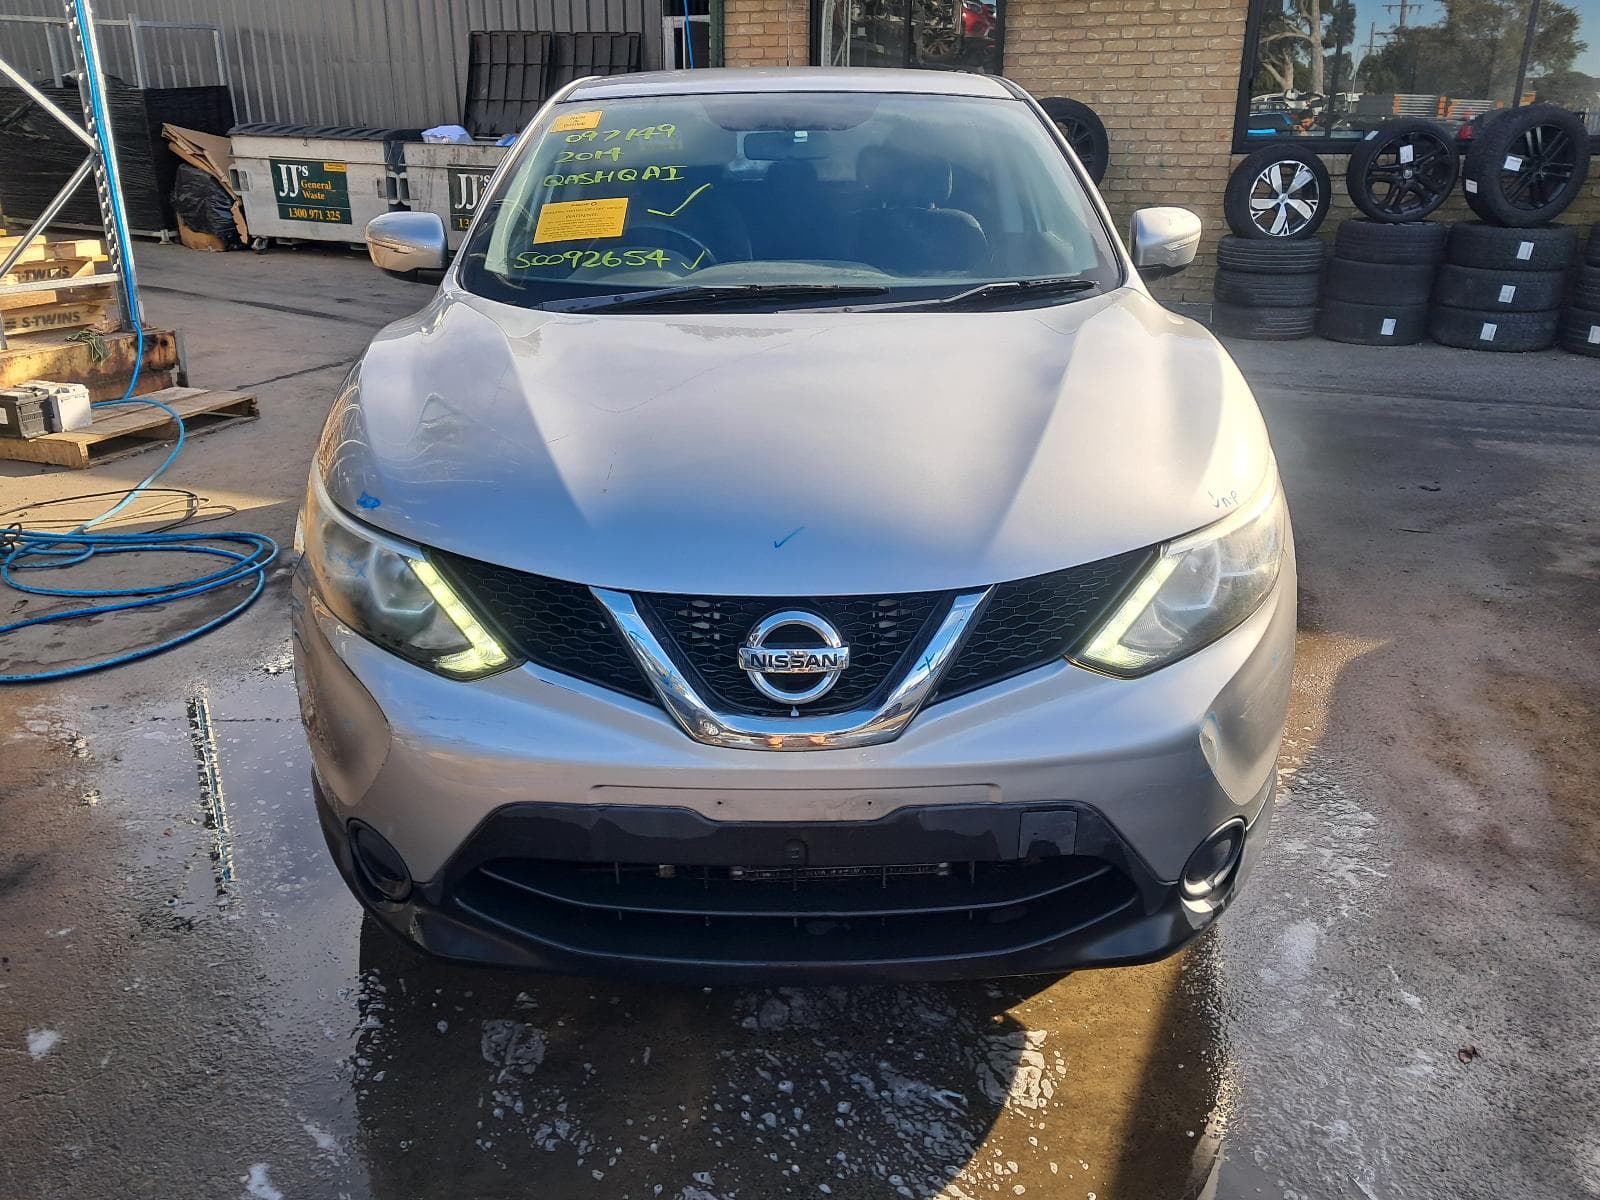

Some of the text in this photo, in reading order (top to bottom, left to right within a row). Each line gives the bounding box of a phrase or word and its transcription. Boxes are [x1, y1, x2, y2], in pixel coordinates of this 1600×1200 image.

[543, 165, 688, 187] QASHQAI
[301, 180, 333, 190] General
[302, 190, 326, 200] Waste
[288, 207, 341, 221] 1300 971 325
[22, 311, 81, 328] S-TWINS
[750, 653, 838, 668] NISSAN
